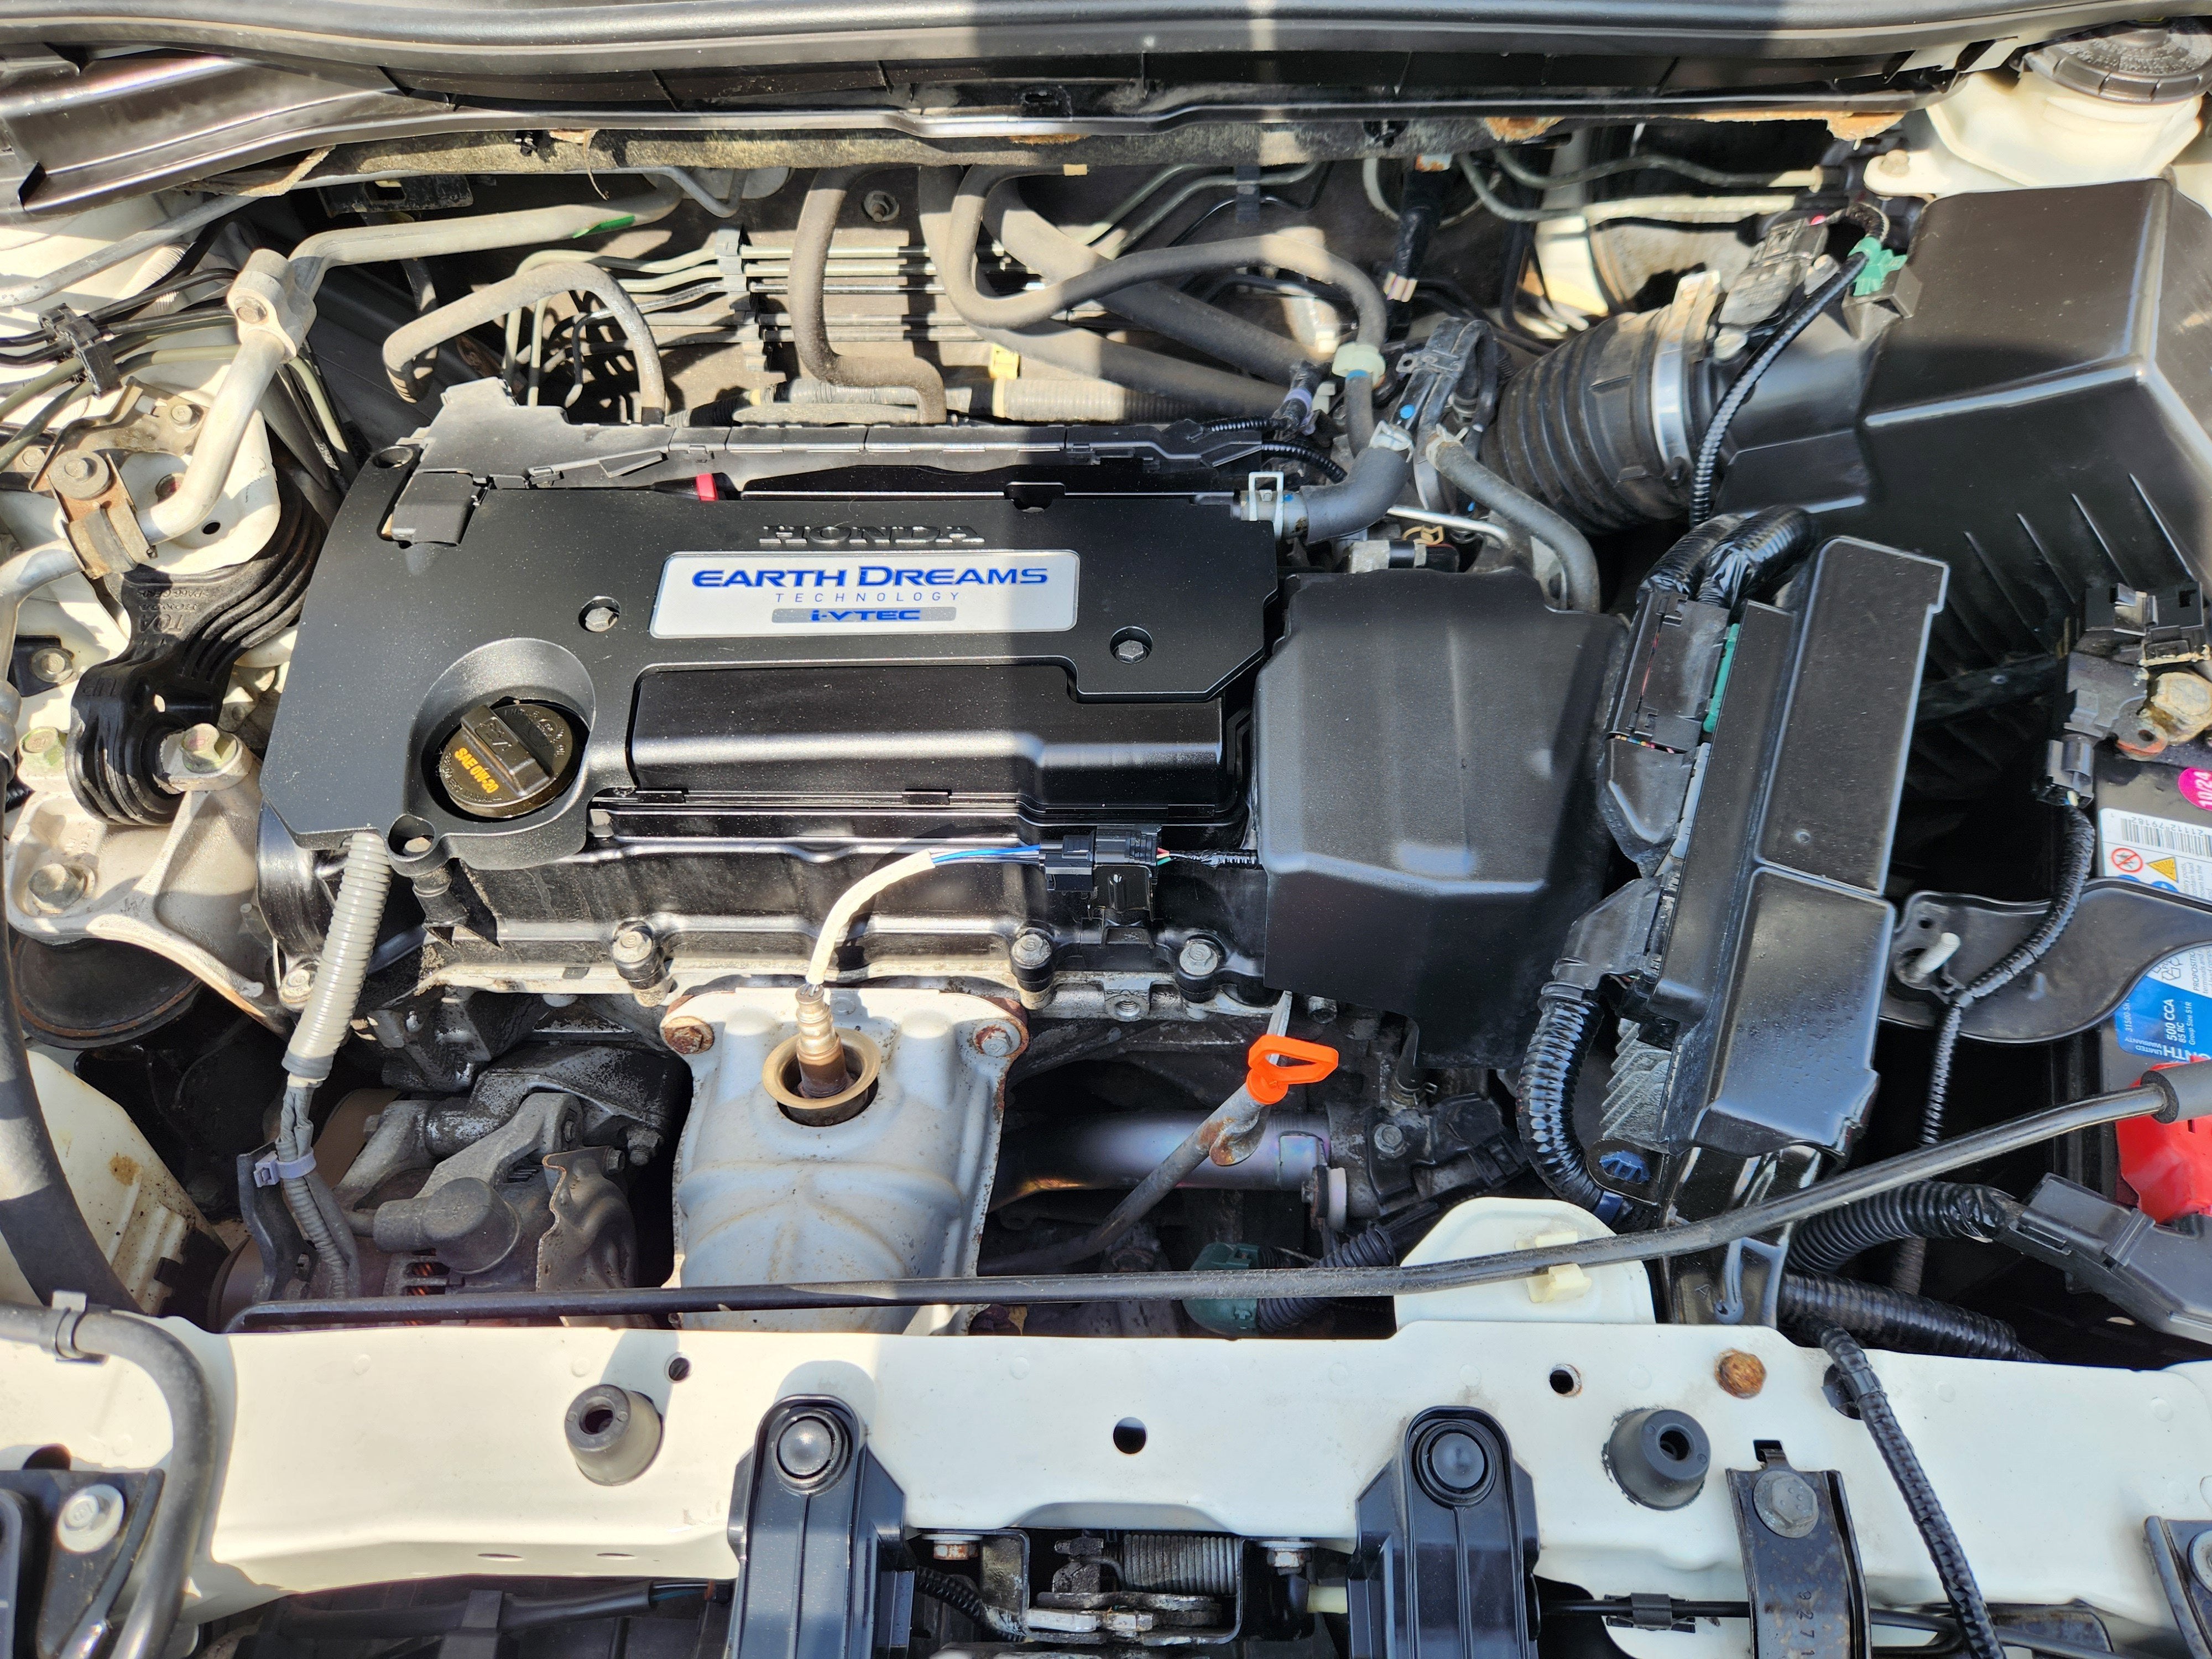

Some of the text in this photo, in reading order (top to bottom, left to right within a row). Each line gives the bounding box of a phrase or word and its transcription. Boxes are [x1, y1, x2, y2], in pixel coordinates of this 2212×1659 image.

[758, 524, 985, 544] HONDA
[691, 565, 1050, 588] EARTH DREAMS
[775, 591, 961, 603] TECHNOLOGY
[810, 609, 921, 623] i-VTEC
[454, 747, 479, 770] SAE
[469, 764, 499, 794] 0W-20
[2193, 771, 2212, 807] 10/24
[2131, 817, 2164, 829] 79182
[2170, 824, 2203, 837] 21112
[2199, 966, 2208, 994] terminals
[2163, 999, 2177, 1041] 500 CCA
[2124, 1036, 2162, 1048] WARRANTY
[2176, 1022, 2187, 1044] 85 RC
[2187, 1028, 2195, 1045] Group
[2135, 1045, 2162, 1055] LIMITED
